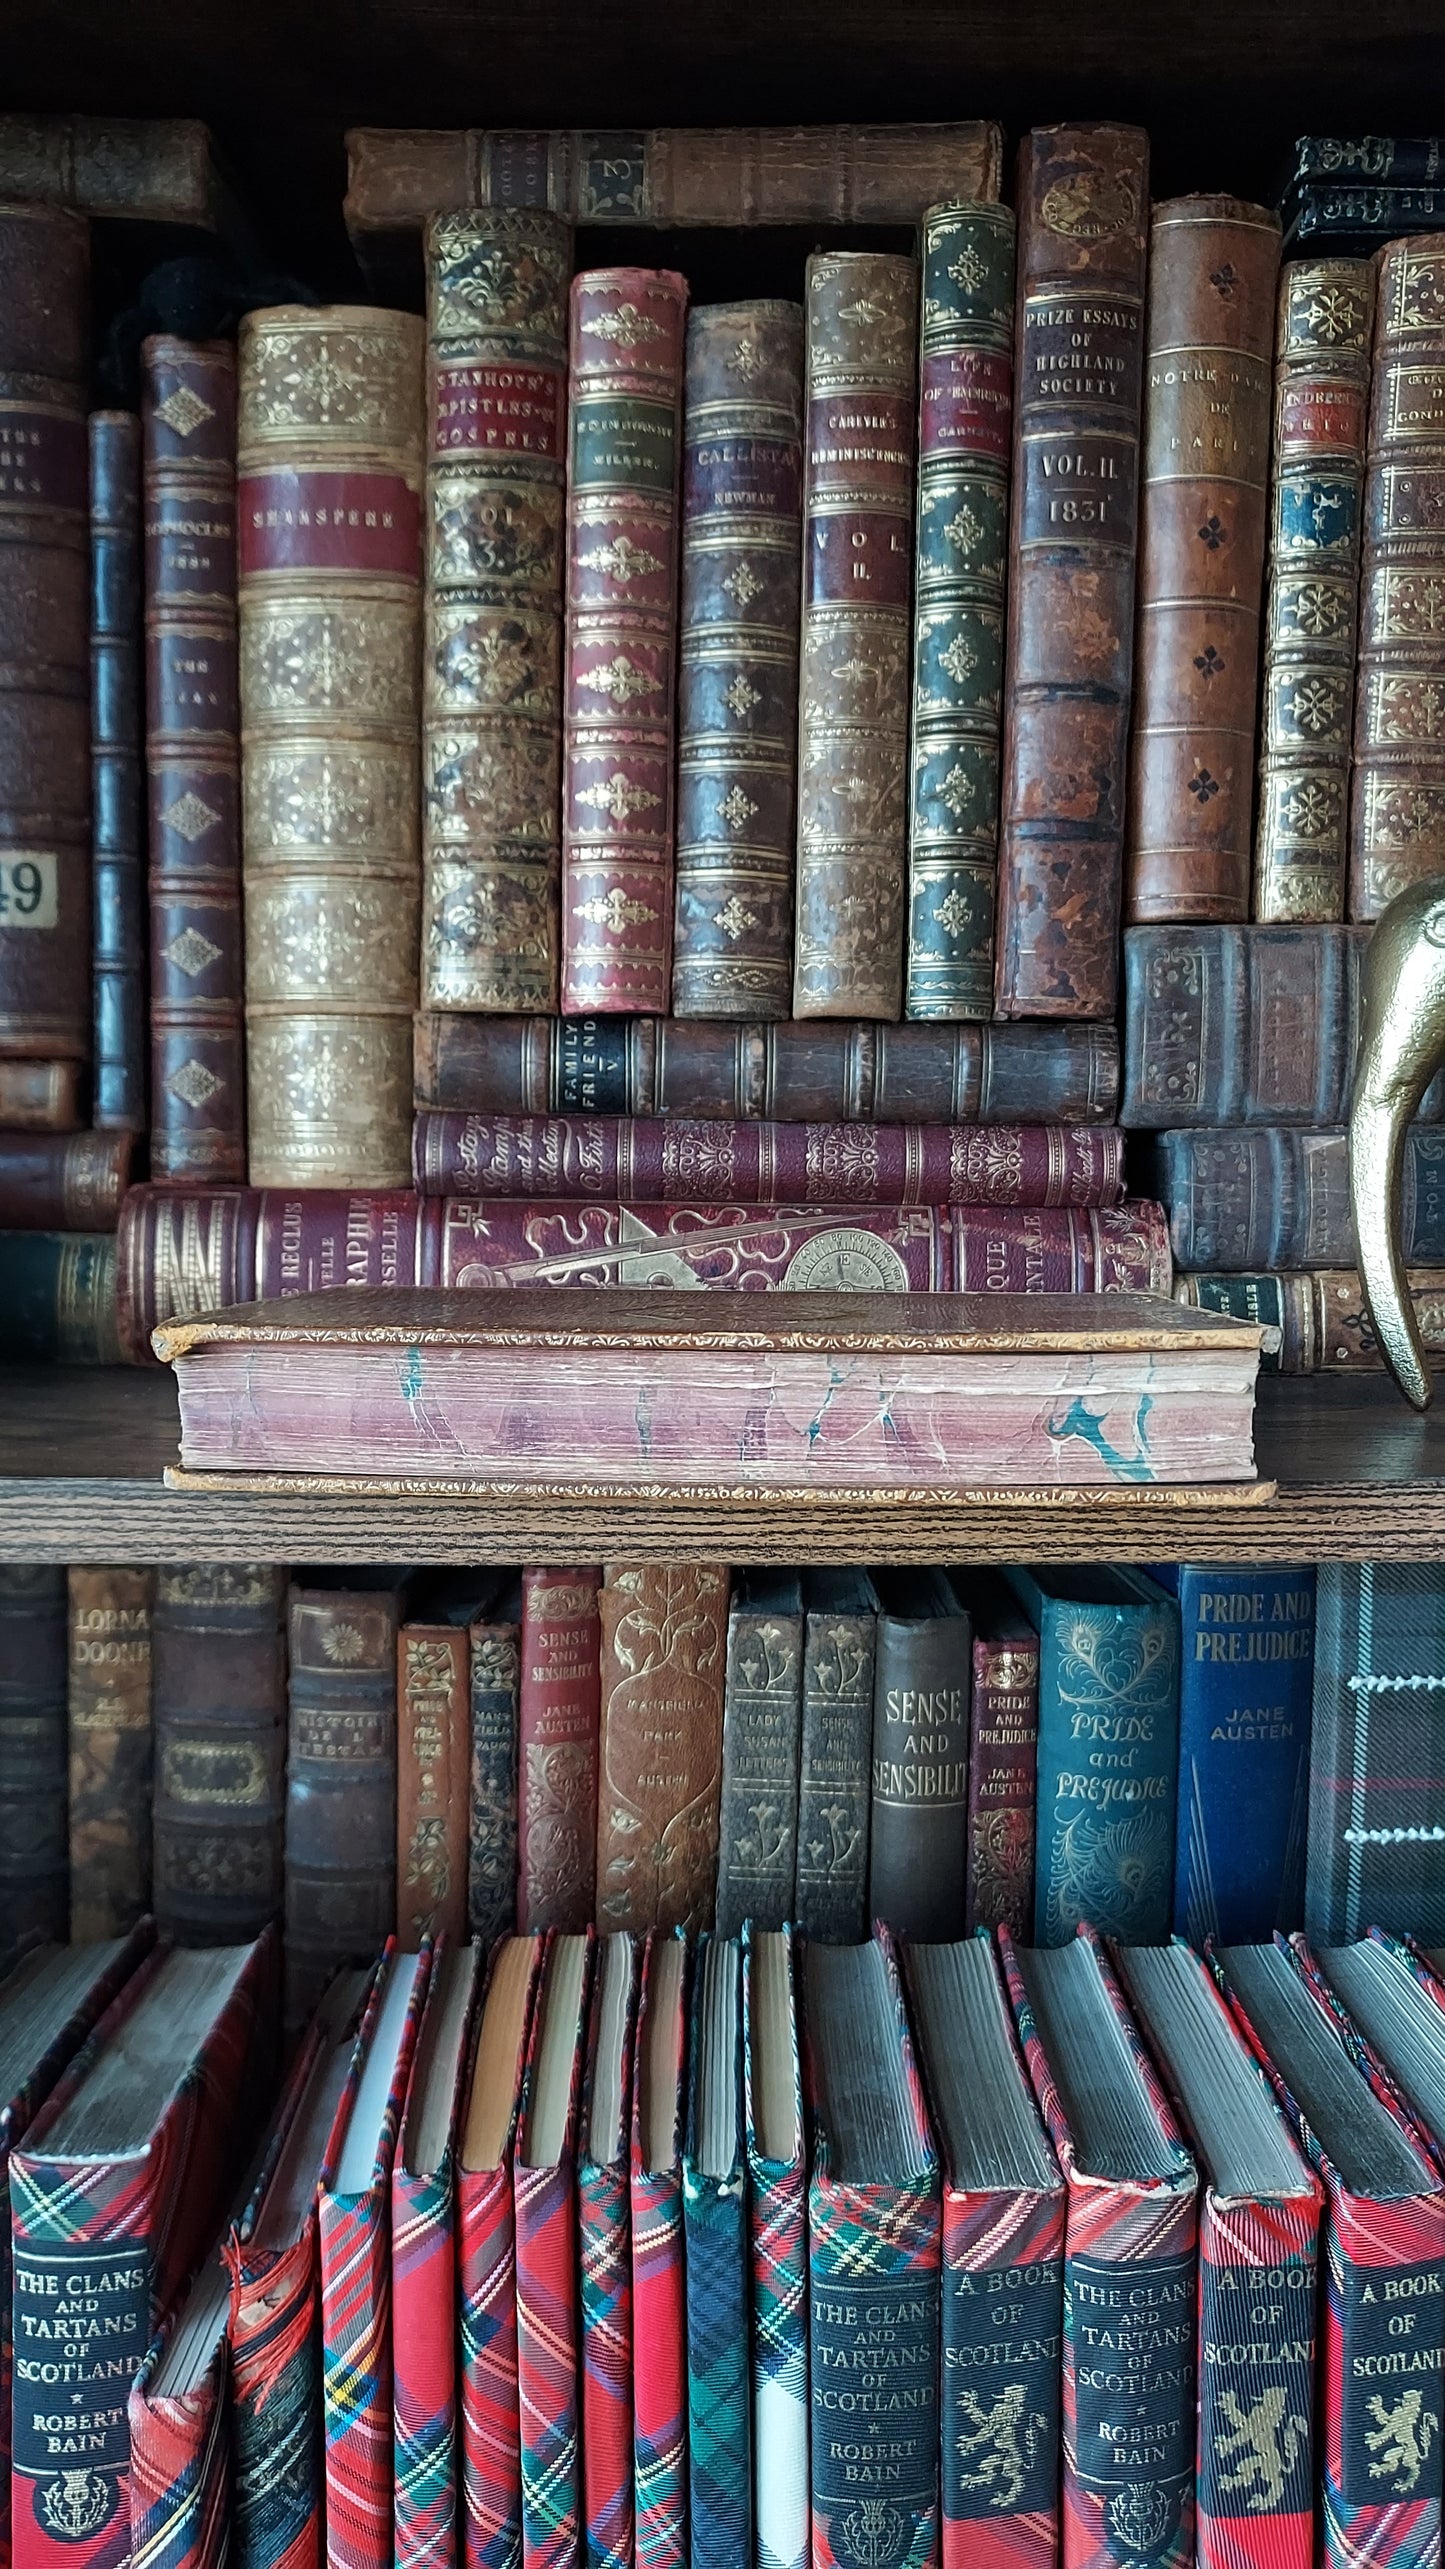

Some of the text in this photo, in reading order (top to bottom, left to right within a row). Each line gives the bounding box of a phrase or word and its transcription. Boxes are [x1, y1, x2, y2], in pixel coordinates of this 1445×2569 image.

[1026, 309, 1137, 330] PRIZE ESSAYS
[1071, 334, 1092, 347] OF
[1035, 355, 1125, 373] HIGHLAND
[1039, 378, 1117, 396] SOCIETY
[1049, 499, 1106, 523] 1831
[564, 1023, 578, 1102] FAMILY
[582, 1020, 597, 1108] FRIEND
[281, 1202, 303, 1278] RECLUS
[1198, 1591, 1312, 1623] PRIDE AND
[74, 1608, 150, 1633] LORNA
[538, 1630, 588, 1648] SENSE
[1195, 1629, 1310, 1662] PREJUDICE
[549, 1650, 578, 1663] AND
[531, 1663, 593, 1681] SENSIBILITY
[543, 1703, 581, 1718] JANE
[885, 1688, 962, 1726] SENSE
[988, 1695, 1031, 1709] PRIDE
[534, 1716, 590, 1734] AUSTEN
[749, 1714, 782, 1727] LADY
[995, 1713, 1022, 1726] AND
[1225, 1706, 1286, 1723] JANE
[978, 1729, 1037, 1745] PREJUDICE
[1069, 1711, 1154, 1741] PRIDE
[1210, 1723, 1294, 1742] AUSTEN
[903, 1735, 949, 1754] AND
[1089, 1747, 1139, 1768] and
[872, 1758, 966, 1799] SENSIBILIT
[988, 1767, 1026, 1780] JANE
[979, 1782, 1033, 1796] AUSTEN
[1055, 1771, 1169, 1812] PREJUDICE
[16, 2268, 144, 2295] THE CLANS
[954, 2261, 1059, 2296] A BOOK
[1217, 2269, 1240, 2290] A
[1359, 2272, 1443, 2304] A BOOK
[1074, 2279, 1122, 2308] THE
[54, 2299, 99, 2314] AND
[814, 2300, 859, 2326] THE
[991, 2303, 1024, 2326] OF
[1250, 2305, 1284, 2325] OF
[21, 2313, 138, 2339] TARTANS
[1117, 2311, 1161, 2327] AND
[1388, 2313, 1417, 2336] OF
[853, 2329, 897, 2346] AND
[1081, 2322, 1192, 2352] TARTANS
[63, 2342, 90, 2358] OF
[817, 2344, 933, 2369] TARTANS
[945, 2334, 1060, 2368] SCOTLAN
[1203, 2338, 1317, 2366] SCOTLAN
[16, 2356, 144, 2384] SCOTLAND
[1126, 2354, 1153, 2371] OF
[861, 2373, 888, 2389] OF
[1077, 2366, 1193, 2394] SCOTLAND
[812, 2388, 934, 2412] SCOTLAND
[32, 2406, 124, 2432] ROBERT
[1097, 2420, 1181, 2443] ROBERT
[46, 2432, 107, 2454] BAIN
[829, 2439, 917, 2461] ROBERT
[1112, 2446, 1167, 2465] BAIN
[845, 2465, 901, 2483] BAIN
